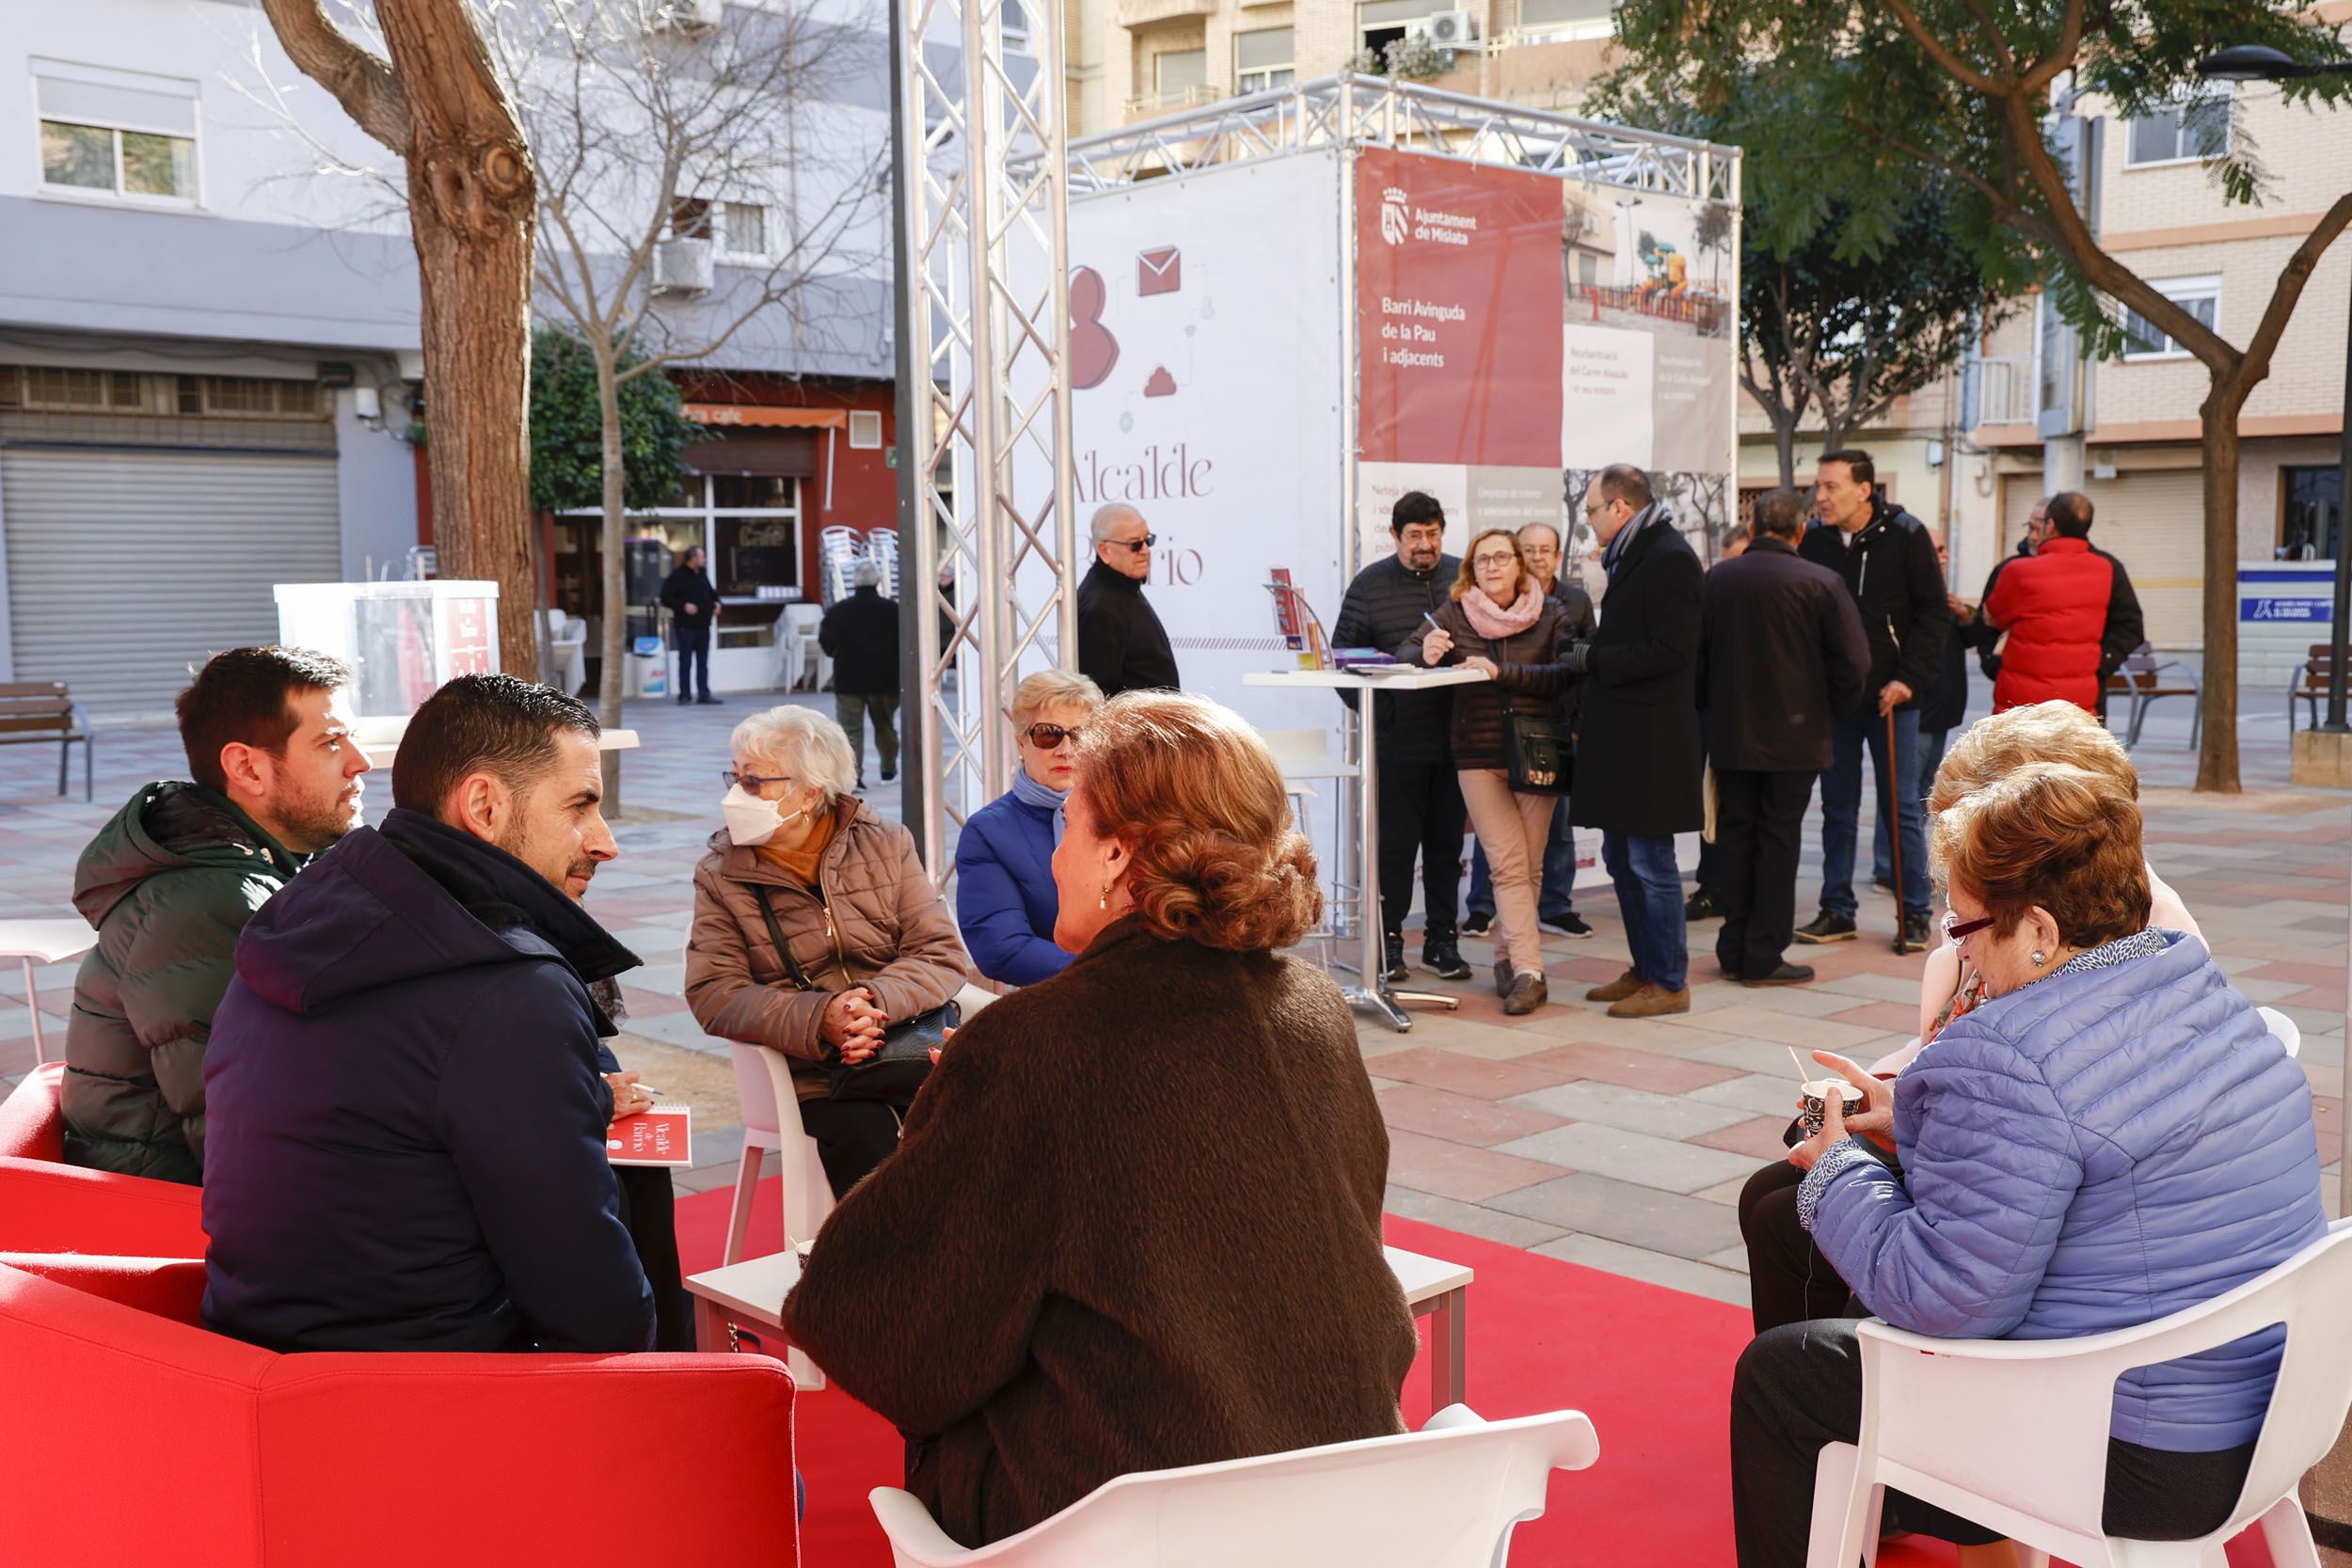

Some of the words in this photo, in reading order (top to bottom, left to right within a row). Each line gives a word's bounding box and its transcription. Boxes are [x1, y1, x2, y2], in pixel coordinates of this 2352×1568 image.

[1415, 208, 1477, 230] Ajuntament
[1415, 228, 1430, 240] de
[1432, 228, 1468, 245] Mislata
[1382, 296, 1411, 315] Barri
[1413, 300, 1466, 322] Avinguda
[1382, 322, 1397, 339] de
[1400, 324, 1411, 341] la
[1414, 325, 1436, 342] Pau
[1383, 347, 1388, 363] i
[1390, 349, 1444, 368] adjacents
